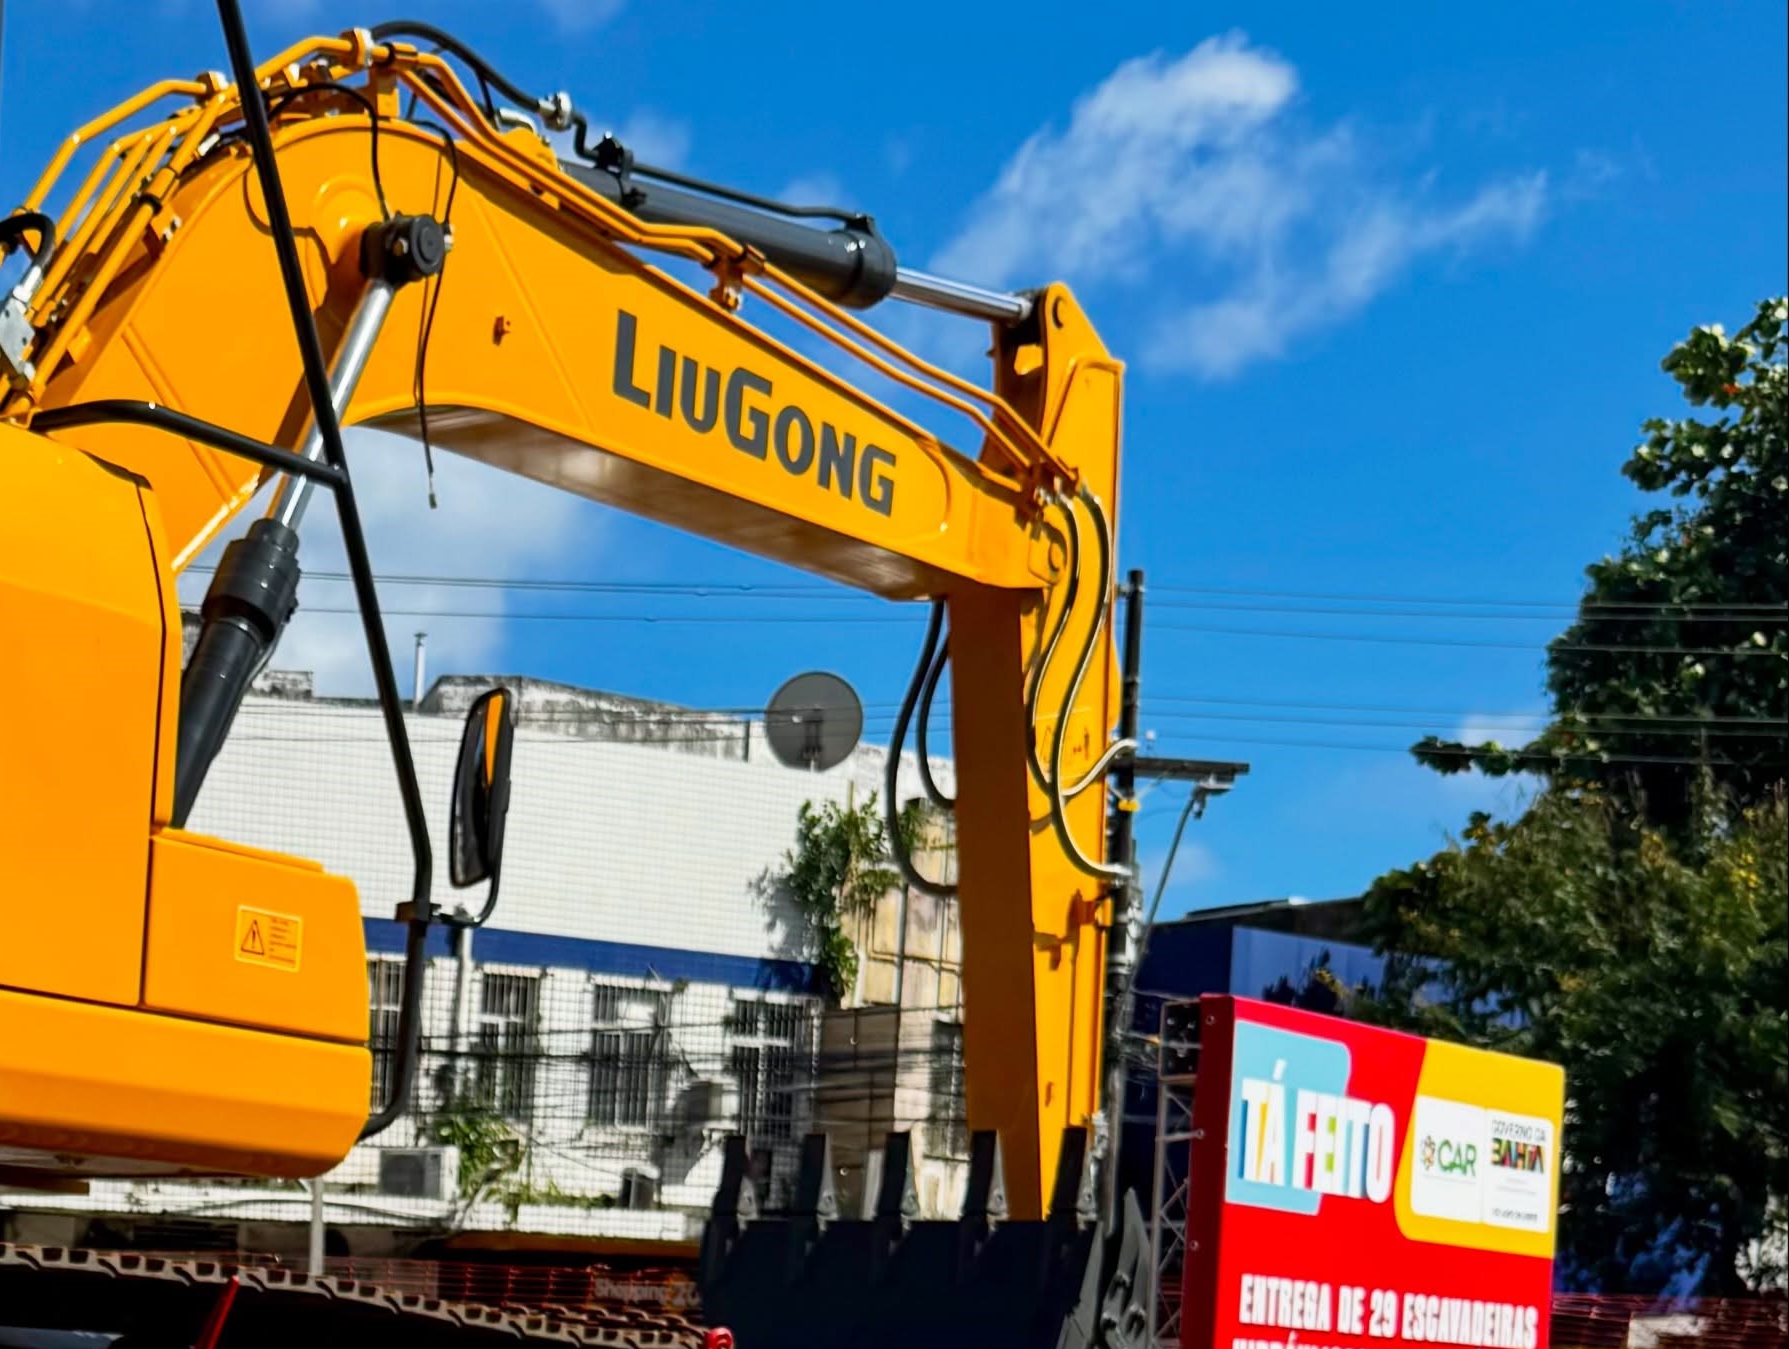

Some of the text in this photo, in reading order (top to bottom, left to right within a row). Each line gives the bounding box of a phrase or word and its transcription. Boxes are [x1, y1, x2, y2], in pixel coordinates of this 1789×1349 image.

[1238, 1058, 1395, 1204] TÁ FEITO
[1437, 1138, 1478, 1178] CAR
[1239, 1273, 1331, 1332] ENTREGA
[1337, 1284, 1366, 1335] DE
[1368, 1288, 1398, 1338] 29
